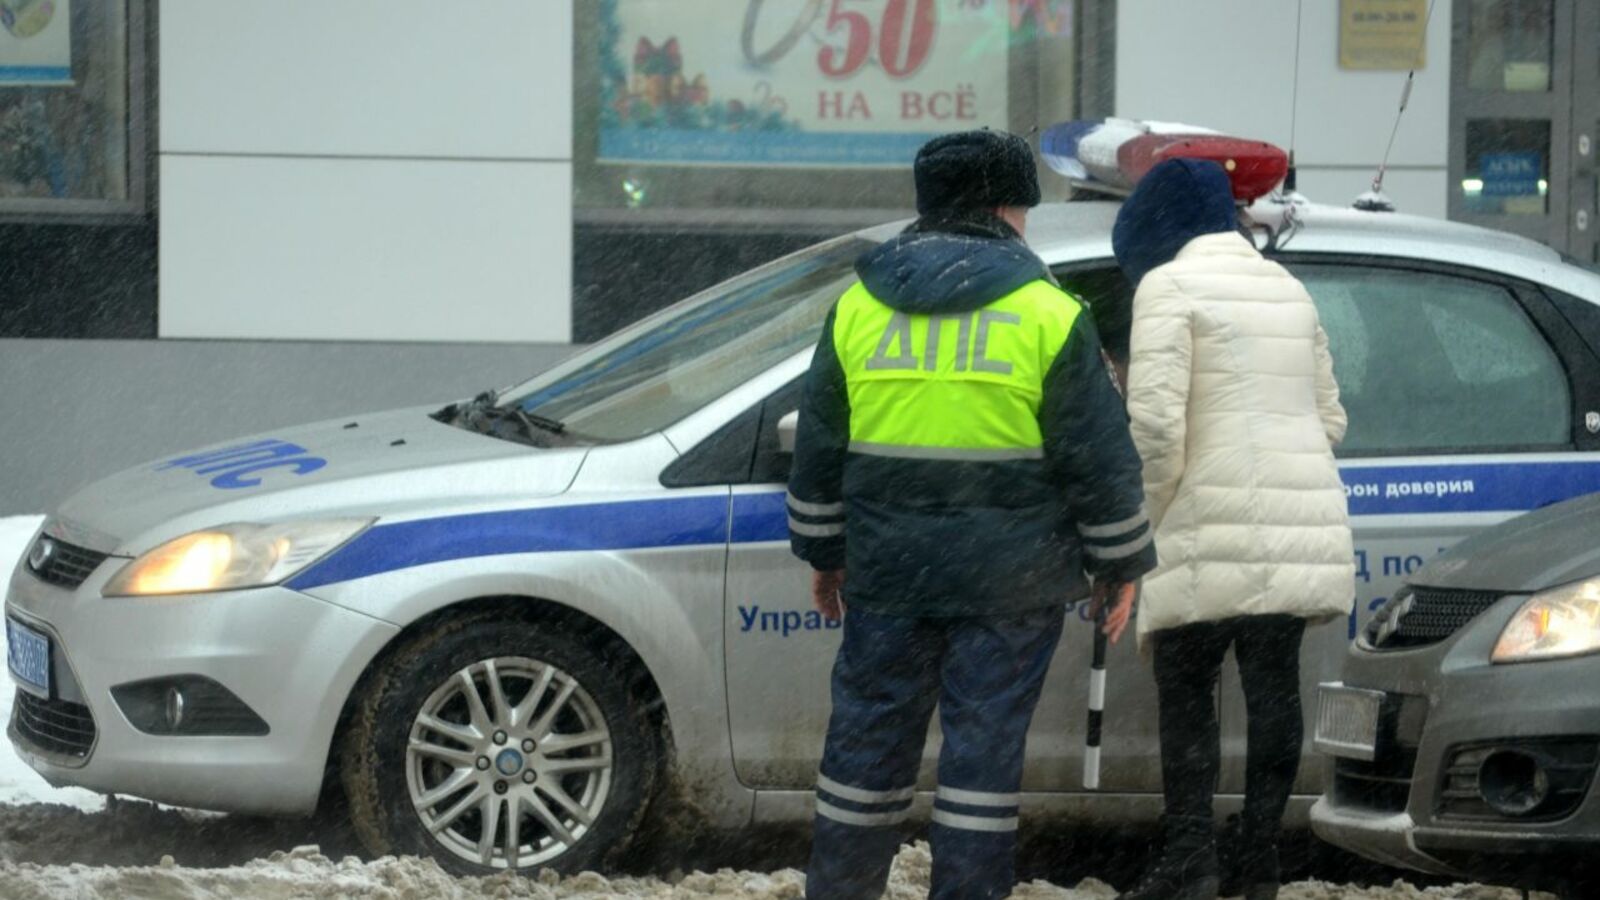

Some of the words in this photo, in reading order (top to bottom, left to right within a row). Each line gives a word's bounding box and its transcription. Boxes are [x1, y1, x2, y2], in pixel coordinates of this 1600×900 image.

[817, 90, 872, 121] НА
[900, 83, 978, 121] ВСЁ
[865, 309, 1021, 375] ДПС
[1385, 480, 1474, 499] доверия
